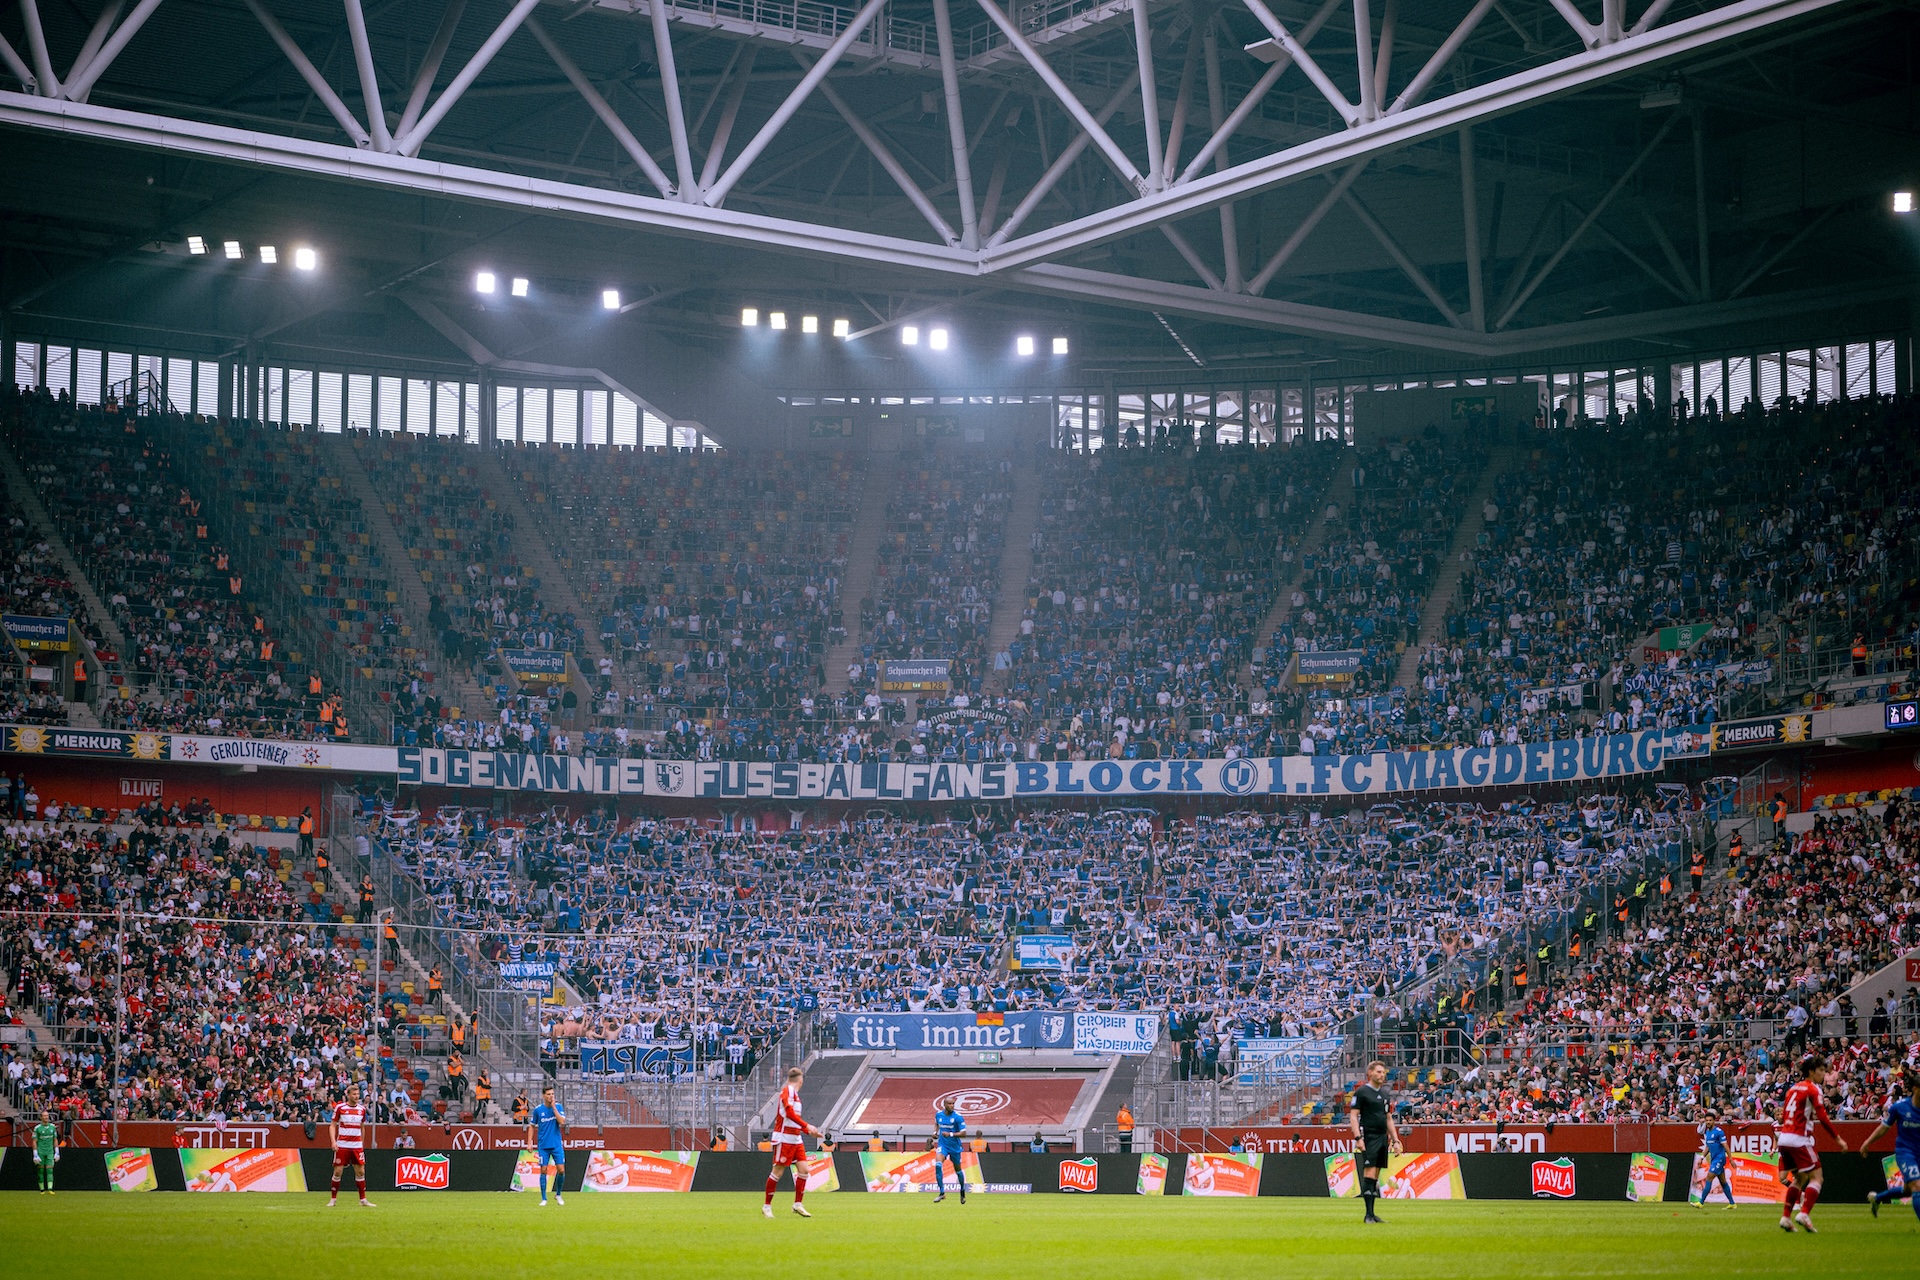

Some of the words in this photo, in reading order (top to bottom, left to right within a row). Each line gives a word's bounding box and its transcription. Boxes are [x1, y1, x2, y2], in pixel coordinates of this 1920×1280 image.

[4, 621, 52, 634] Schumacher
[54, 624, 66, 635] Alt
[48, 642, 61, 650] 124
[505, 656, 550, 666] Schumacher
[552, 658, 563, 667] Alt
[1301, 658, 1346, 668] Schumacher
[546, 674, 560, 682] 126
[887, 666, 933, 676] Schumacher
[936, 666, 947, 675] Alt
[891, 682, 904, 690] 127
[929, 682, 944, 690] 128
[1724, 724, 1776, 742] MERKUR
[54, 734, 122, 750] MERKUR
[210, 741, 288, 765] GEROLSTEINER
[1016, 760, 1203, 792] BLOCK
[1269, 756, 1373, 793] 1.FC
[1385, 729, 1664, 791] MAGDEBURG
[399, 748, 643, 794] SOGENANNTE
[121, 780, 162, 797] D.LIVE
[1912, 962, 1920, 978] 2
[850, 1016, 900, 1047] für
[921, 1018, 1026, 1048] immer
[1077, 1028, 1098, 1038] 1.FC
[1077, 1039, 1153, 1052] MAGDEBURG
[592, 1046, 690, 1076] 1965
[1786, 1092, 1798, 1118] 4
[561, 1140, 605, 1148] UPPE
[401, 1162, 444, 1183] YAYLA
[1064, 1166, 1094, 1186] YAYLA
[1536, 1166, 1572, 1190] YAYLA
[1909, 1164, 1920, 1178] 23
